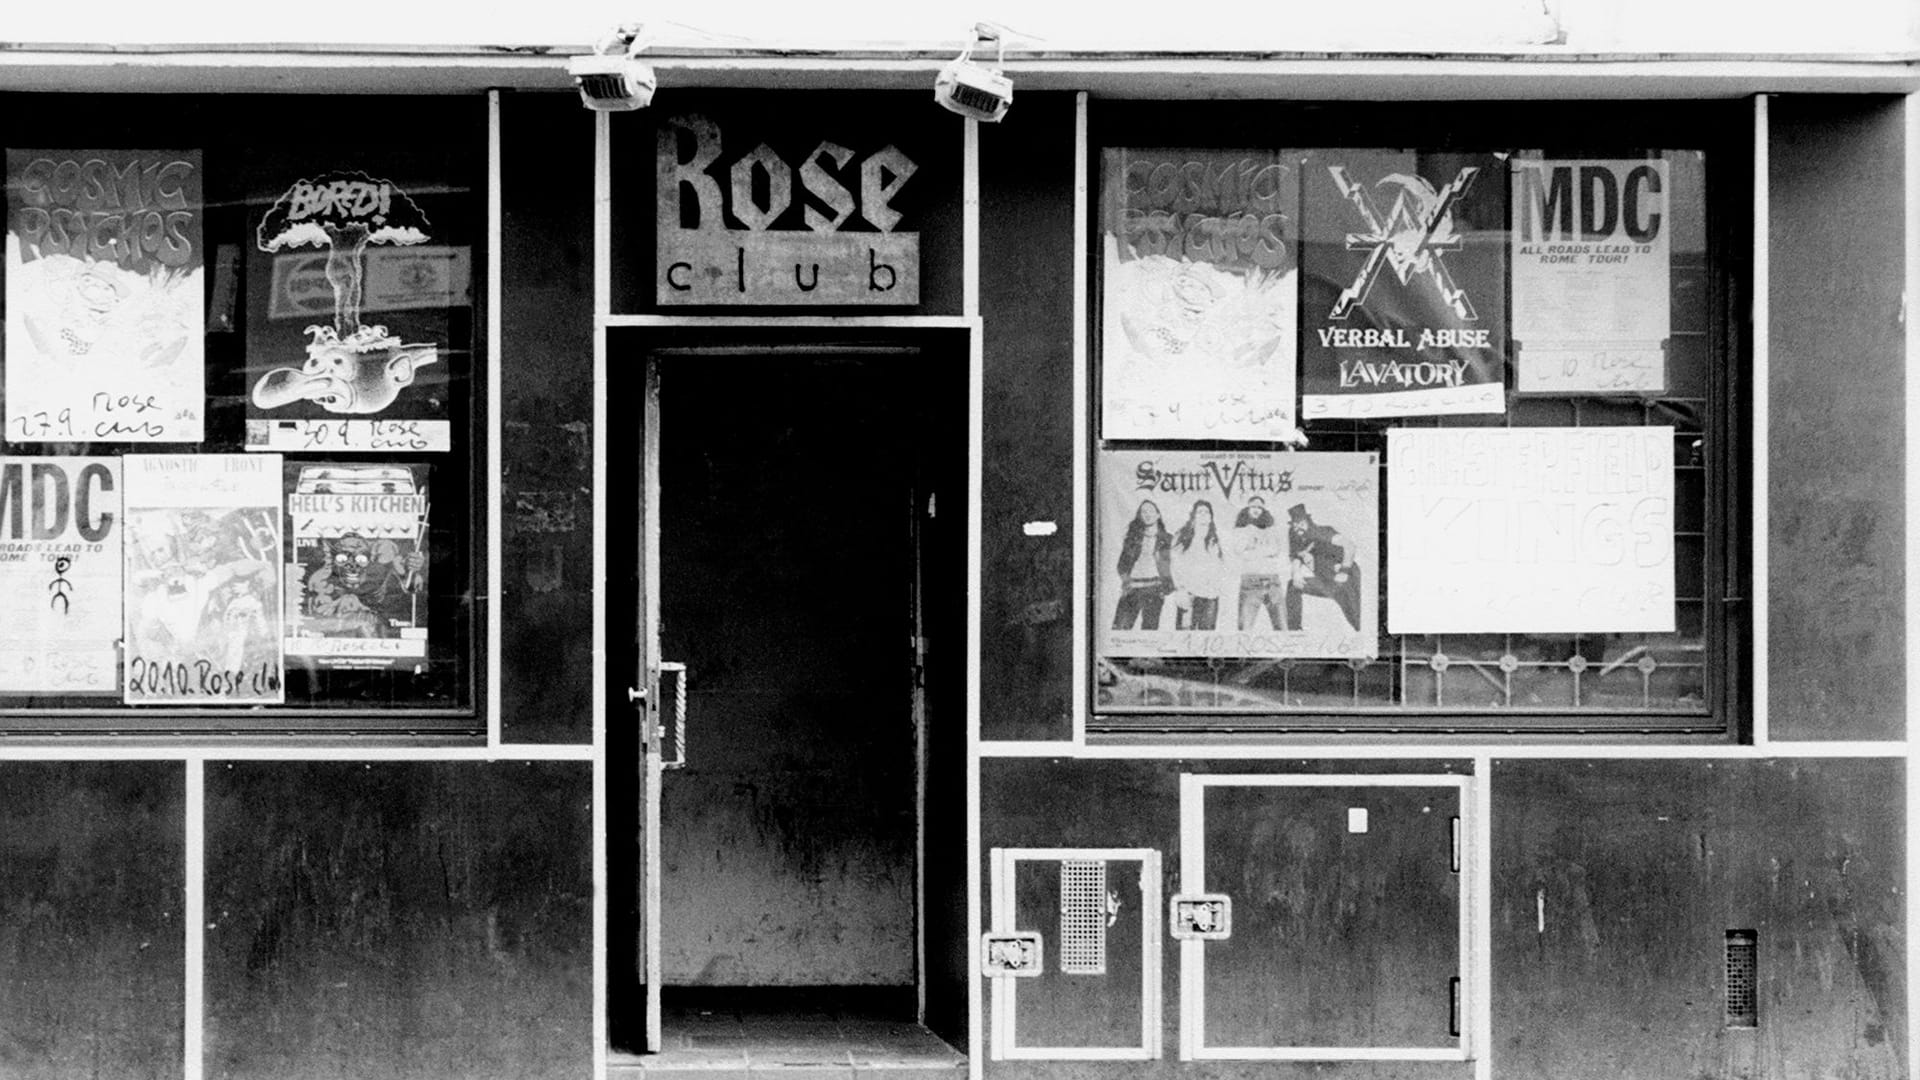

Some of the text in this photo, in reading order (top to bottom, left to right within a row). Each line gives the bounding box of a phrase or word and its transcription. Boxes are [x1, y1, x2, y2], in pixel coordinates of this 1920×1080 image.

[657, 113, 919, 231] Rose
[1521, 165, 1662, 243] MDC
[1520, 246, 1543, 255] ALL
[1547, 245, 1591, 254] ROADS
[1595, 245, 1630, 254] LEAD
[1540, 255, 1578, 264] ROME
[667, 247, 896, 292] club
[1317, 327, 1492, 351] VERBAL ABUSE
[1339, 359, 1470, 388] LAVATORY
[1135, 460, 1213, 495] Saint
[1201, 459, 1295, 500] Vitus
[291, 495, 423, 514] HELL'S KITCHEN
[1397, 495, 1672, 569] KINGS
